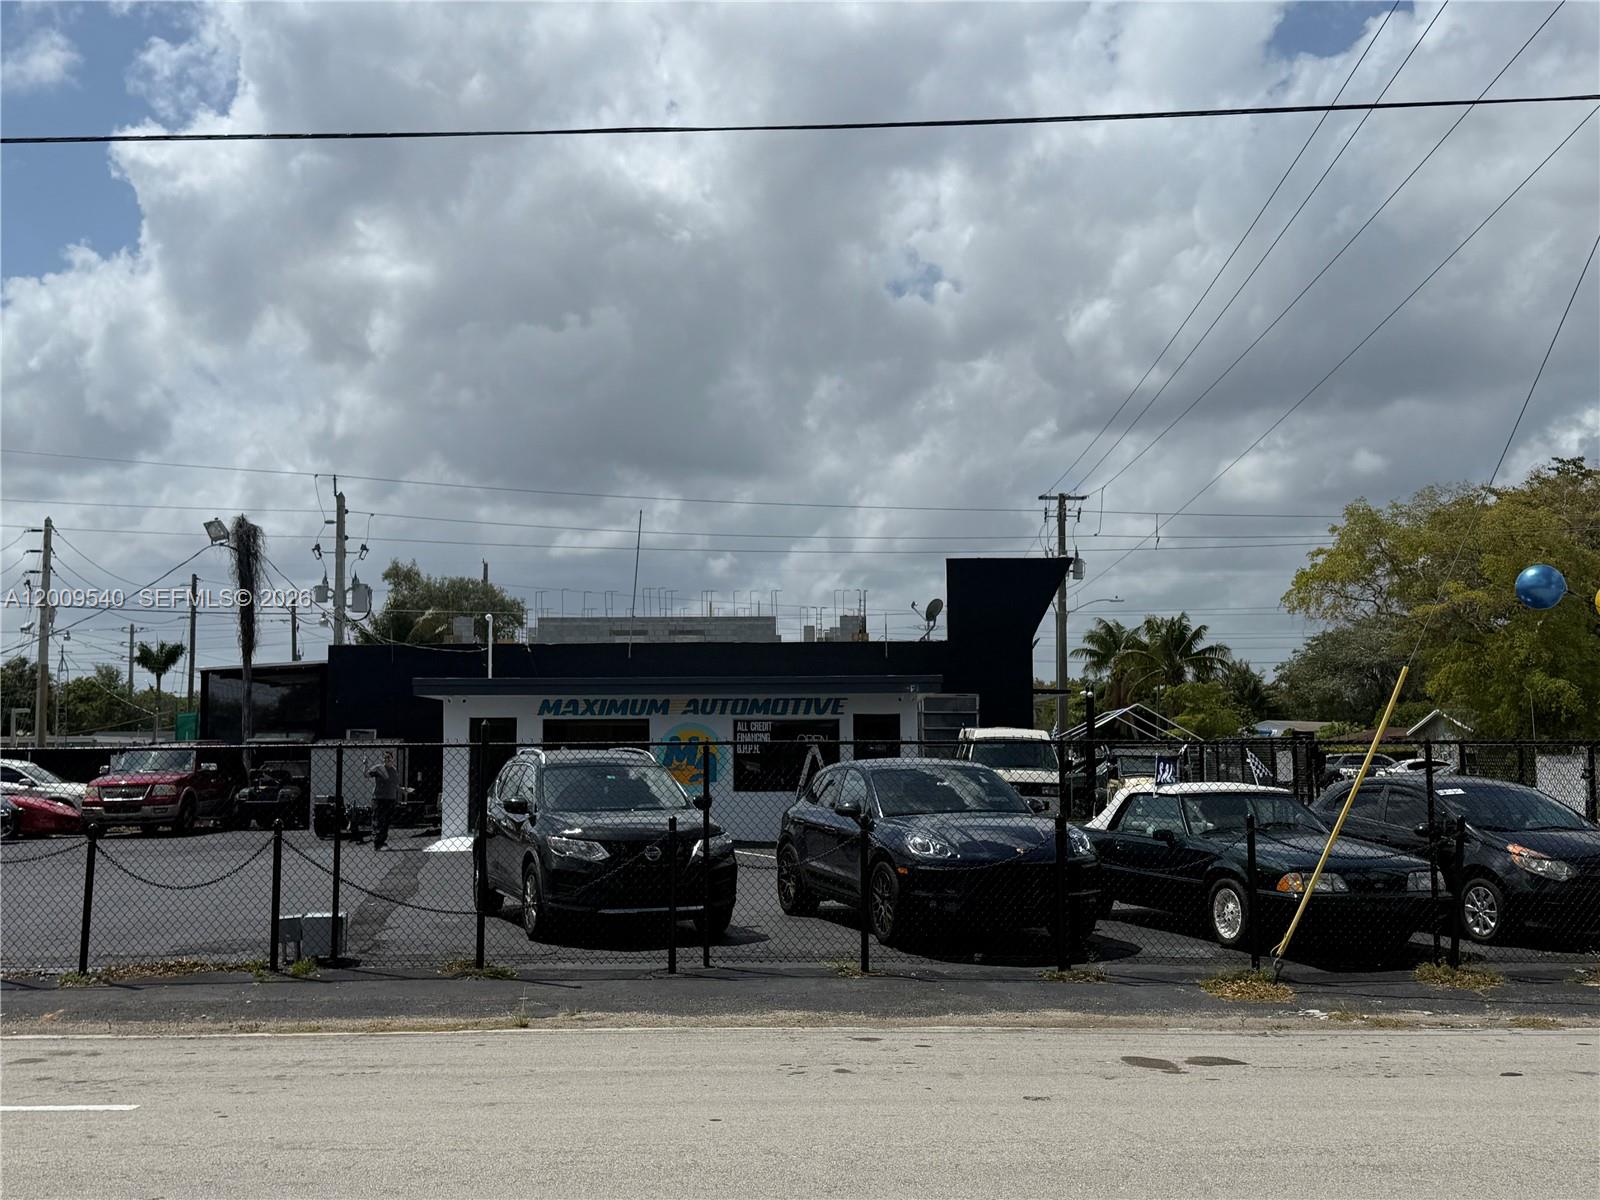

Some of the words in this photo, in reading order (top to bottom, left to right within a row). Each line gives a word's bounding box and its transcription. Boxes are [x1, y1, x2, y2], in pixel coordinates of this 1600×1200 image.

[537, 698, 670, 716] MAXIMUM
[681, 697, 848, 715] AUTOMOTIVE
[737, 721, 749, 732] ALL
[750, 721, 772, 732] CREDIT
[737, 732, 771, 743] FINANCING
